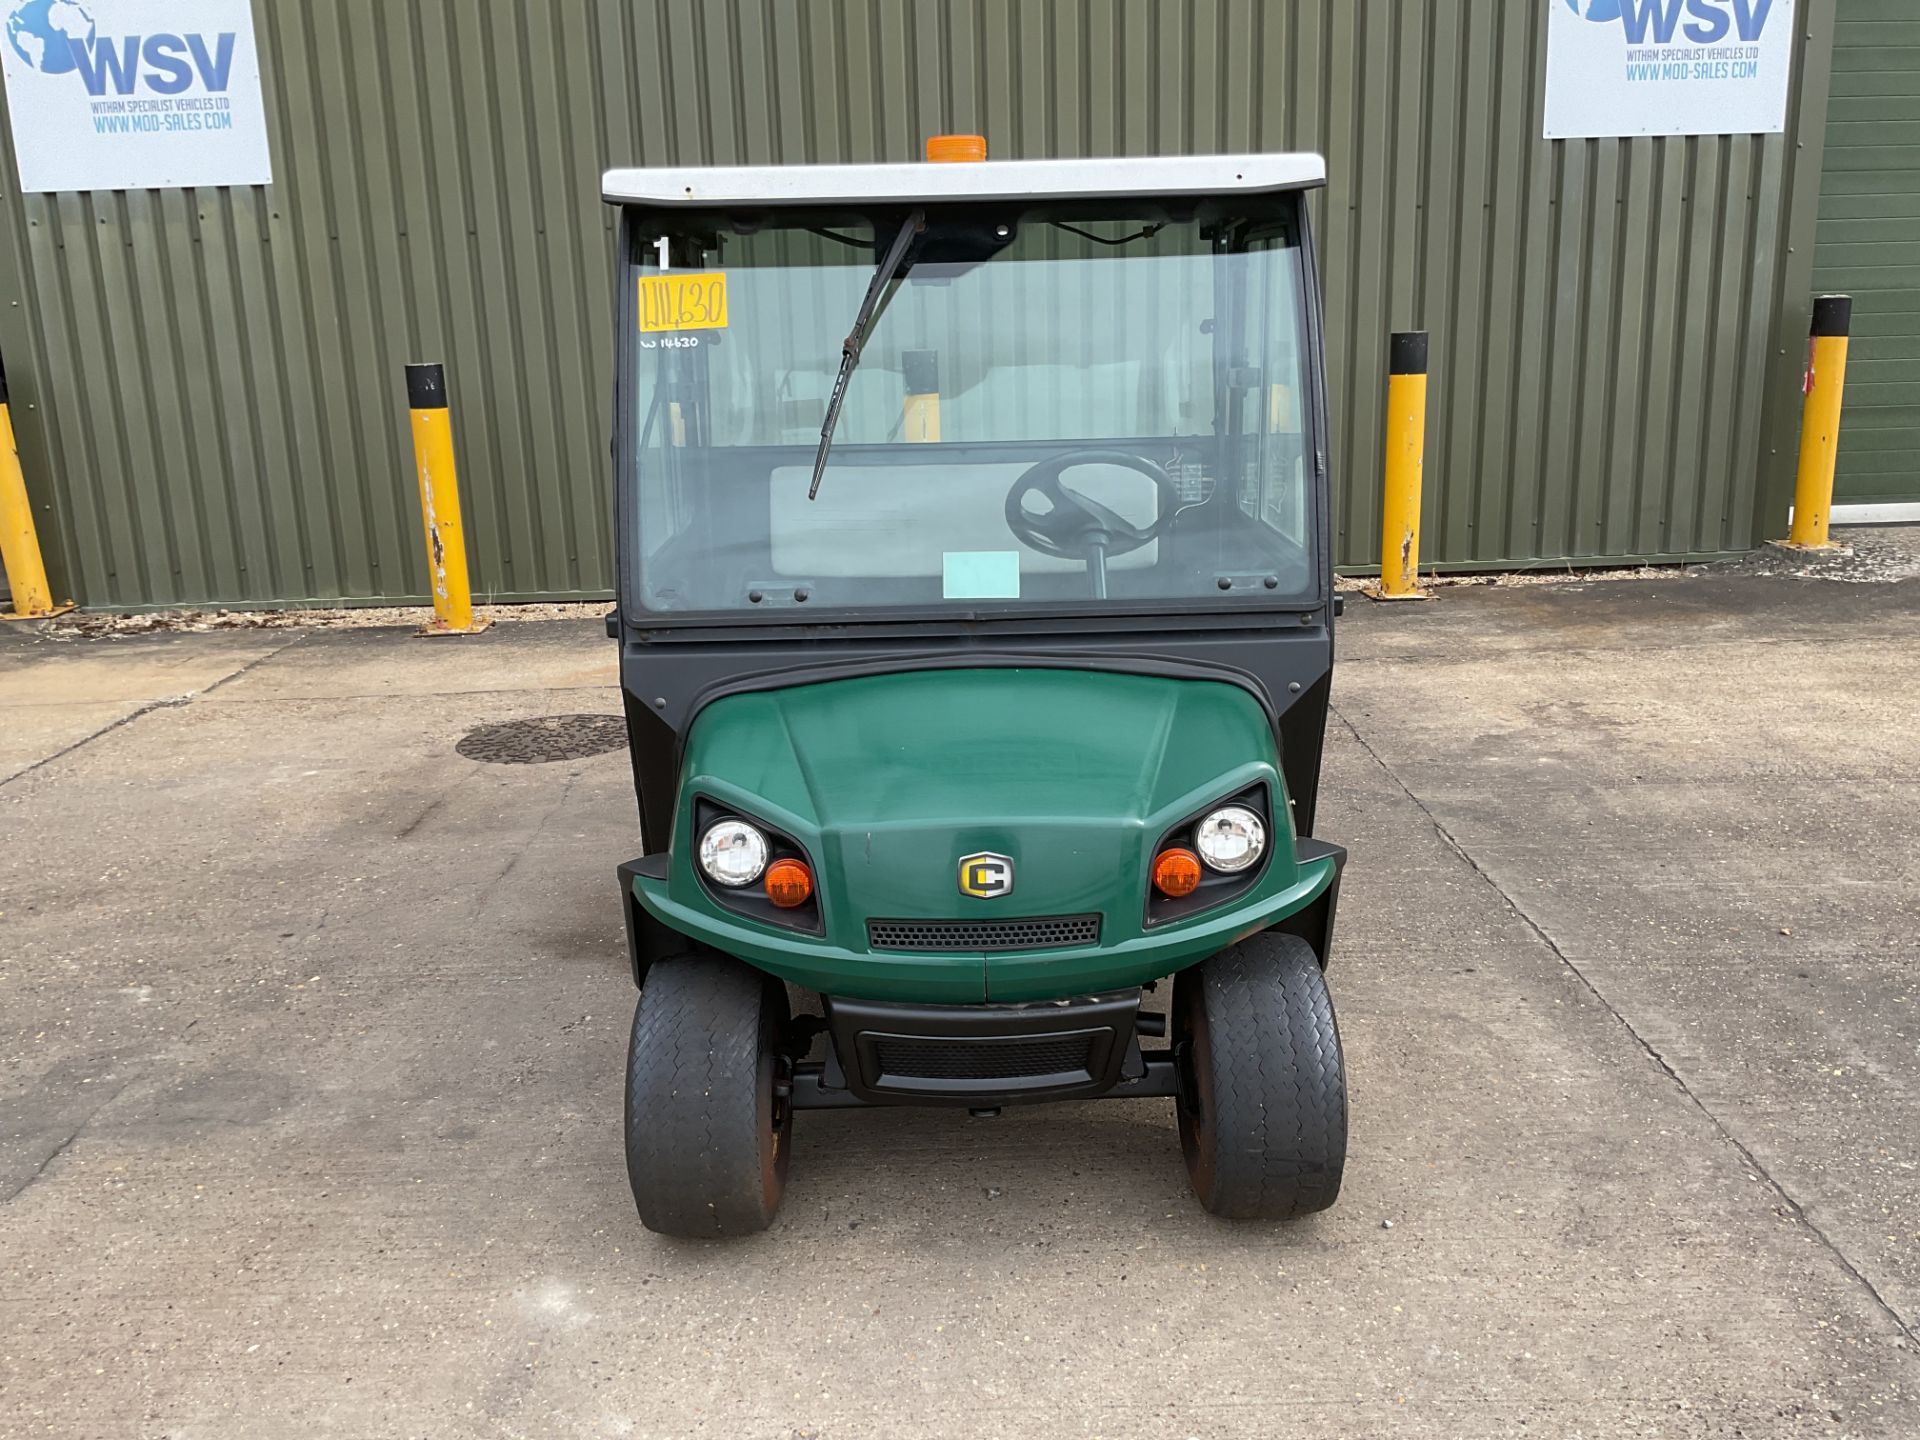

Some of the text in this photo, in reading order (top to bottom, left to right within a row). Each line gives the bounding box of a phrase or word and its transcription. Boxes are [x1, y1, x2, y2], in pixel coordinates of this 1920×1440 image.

[1618, 0, 1774, 44] WSV
[67, 32, 236, 96] WSV
[1626, 47, 1759, 62] WITHAM SPECIALIST VEHICLES LTD
[1626, 61, 1757, 81] WWWMOD-SALESCOM
[90, 97, 230, 115] WITHAM SPECIALIST VEHICLES LTD
[93, 112, 232, 134] WWWMOD-SALESCOM
[653, 236, 670, 271] 1
[660, 337, 699, 349] 14630
